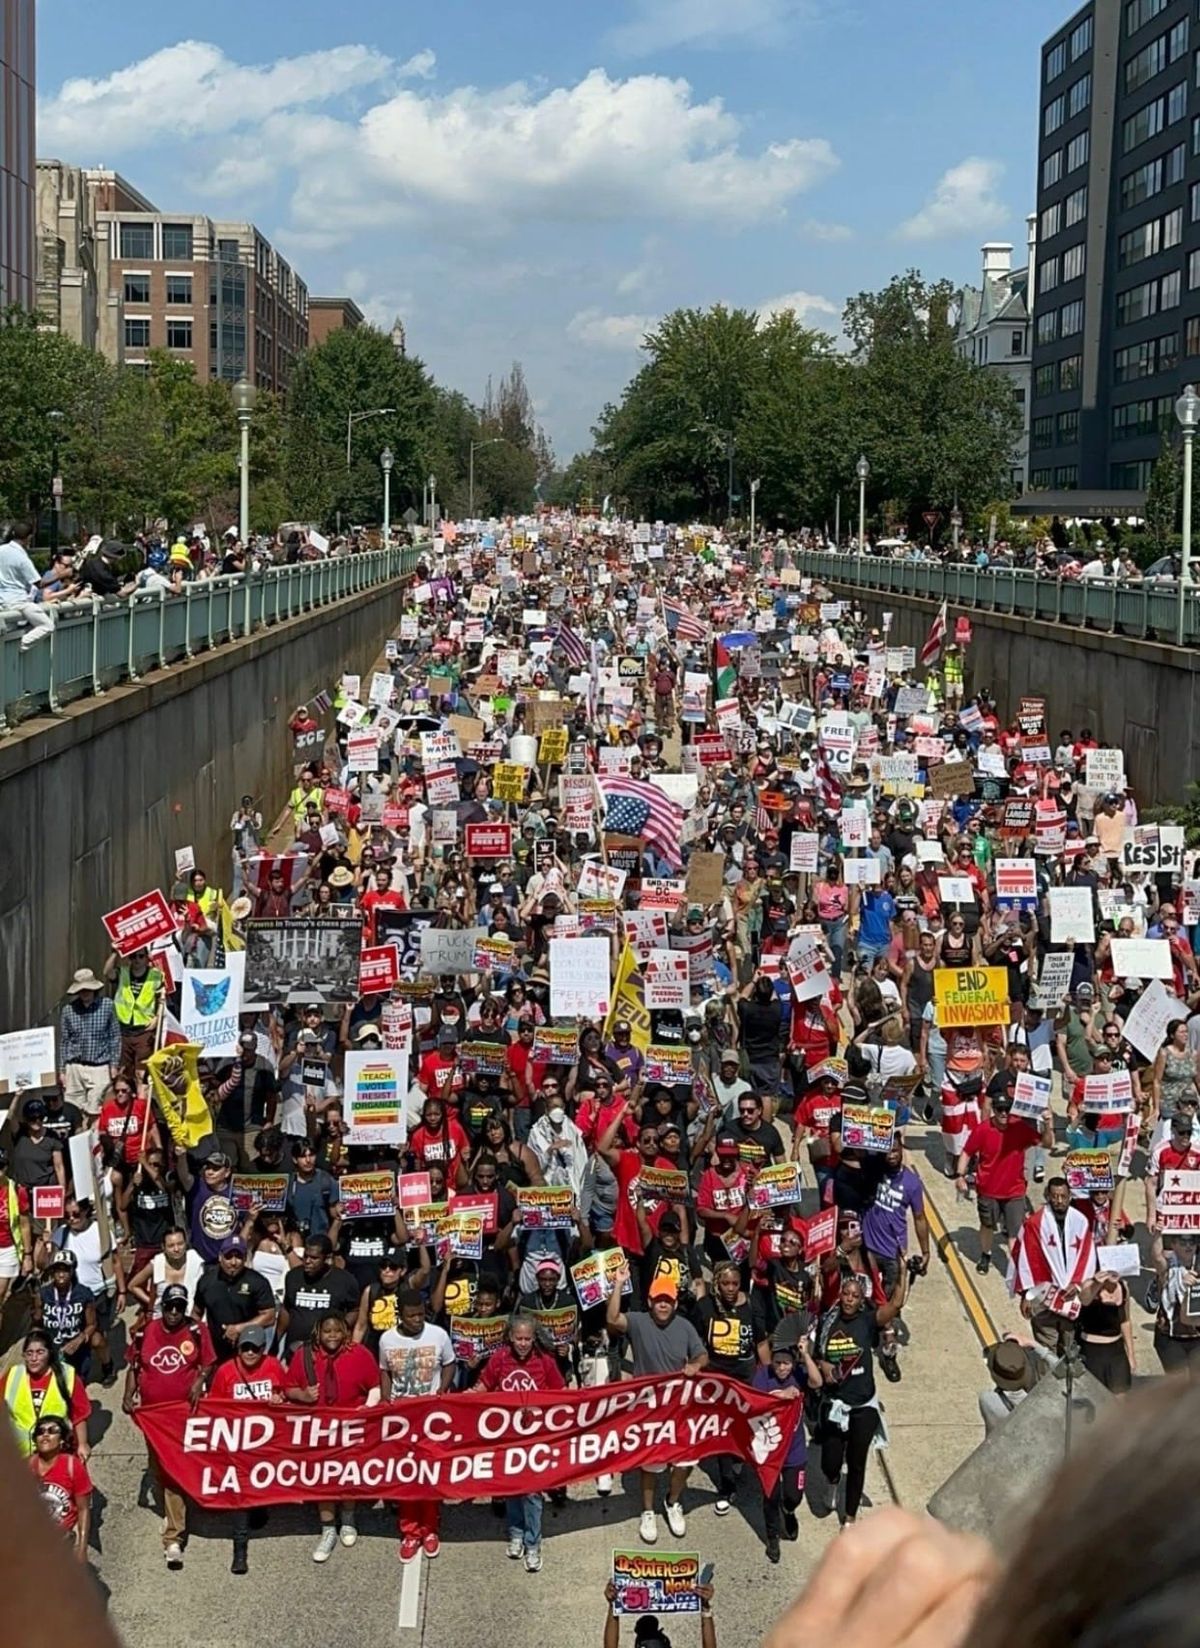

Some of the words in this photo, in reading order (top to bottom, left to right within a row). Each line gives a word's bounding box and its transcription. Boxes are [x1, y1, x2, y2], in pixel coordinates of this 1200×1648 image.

[824, 727, 851, 737] FREE
[296, 729, 325, 748] ICE
[426, 744, 456, 753] WANTS
[826, 749, 850, 763] DC
[608, 850, 639, 859] TRUMP
[612, 859, 636, 869] MUST
[655, 887, 670, 897] DC
[437, 934, 473, 947] FUCK
[427, 950, 467, 961] TRUM
[376, 966, 393, 977] DC
[957, 971, 988, 991] END
[944, 990, 997, 1003] FEDERAL
[943, 1004, 1004, 1022] INVASION
[363, 1072, 391, 1080] TEACH
[364, 1082, 387, 1090] VOTE
[361, 1092, 392, 1100] RESIST
[354, 1101, 399, 1110] ORGANIZE
[150, 1353, 188, 1368] CASA
[501, 1378, 539, 1392] CASA
[183, 1414, 275, 1452] END
[286, 1414, 367, 1448] THE
[380, 1411, 463, 1443] D.C.
[477, 1378, 751, 1440] OCCUPATION
[201, 1465, 242, 1496] LA
[250, 1452, 442, 1489] OCUPACIÓN
[450, 1452, 495, 1484] DE
[504, 1446, 561, 1475] DC:
[687, 1413, 734, 1441] YA!
[626, 1587, 650, 1609] 51
